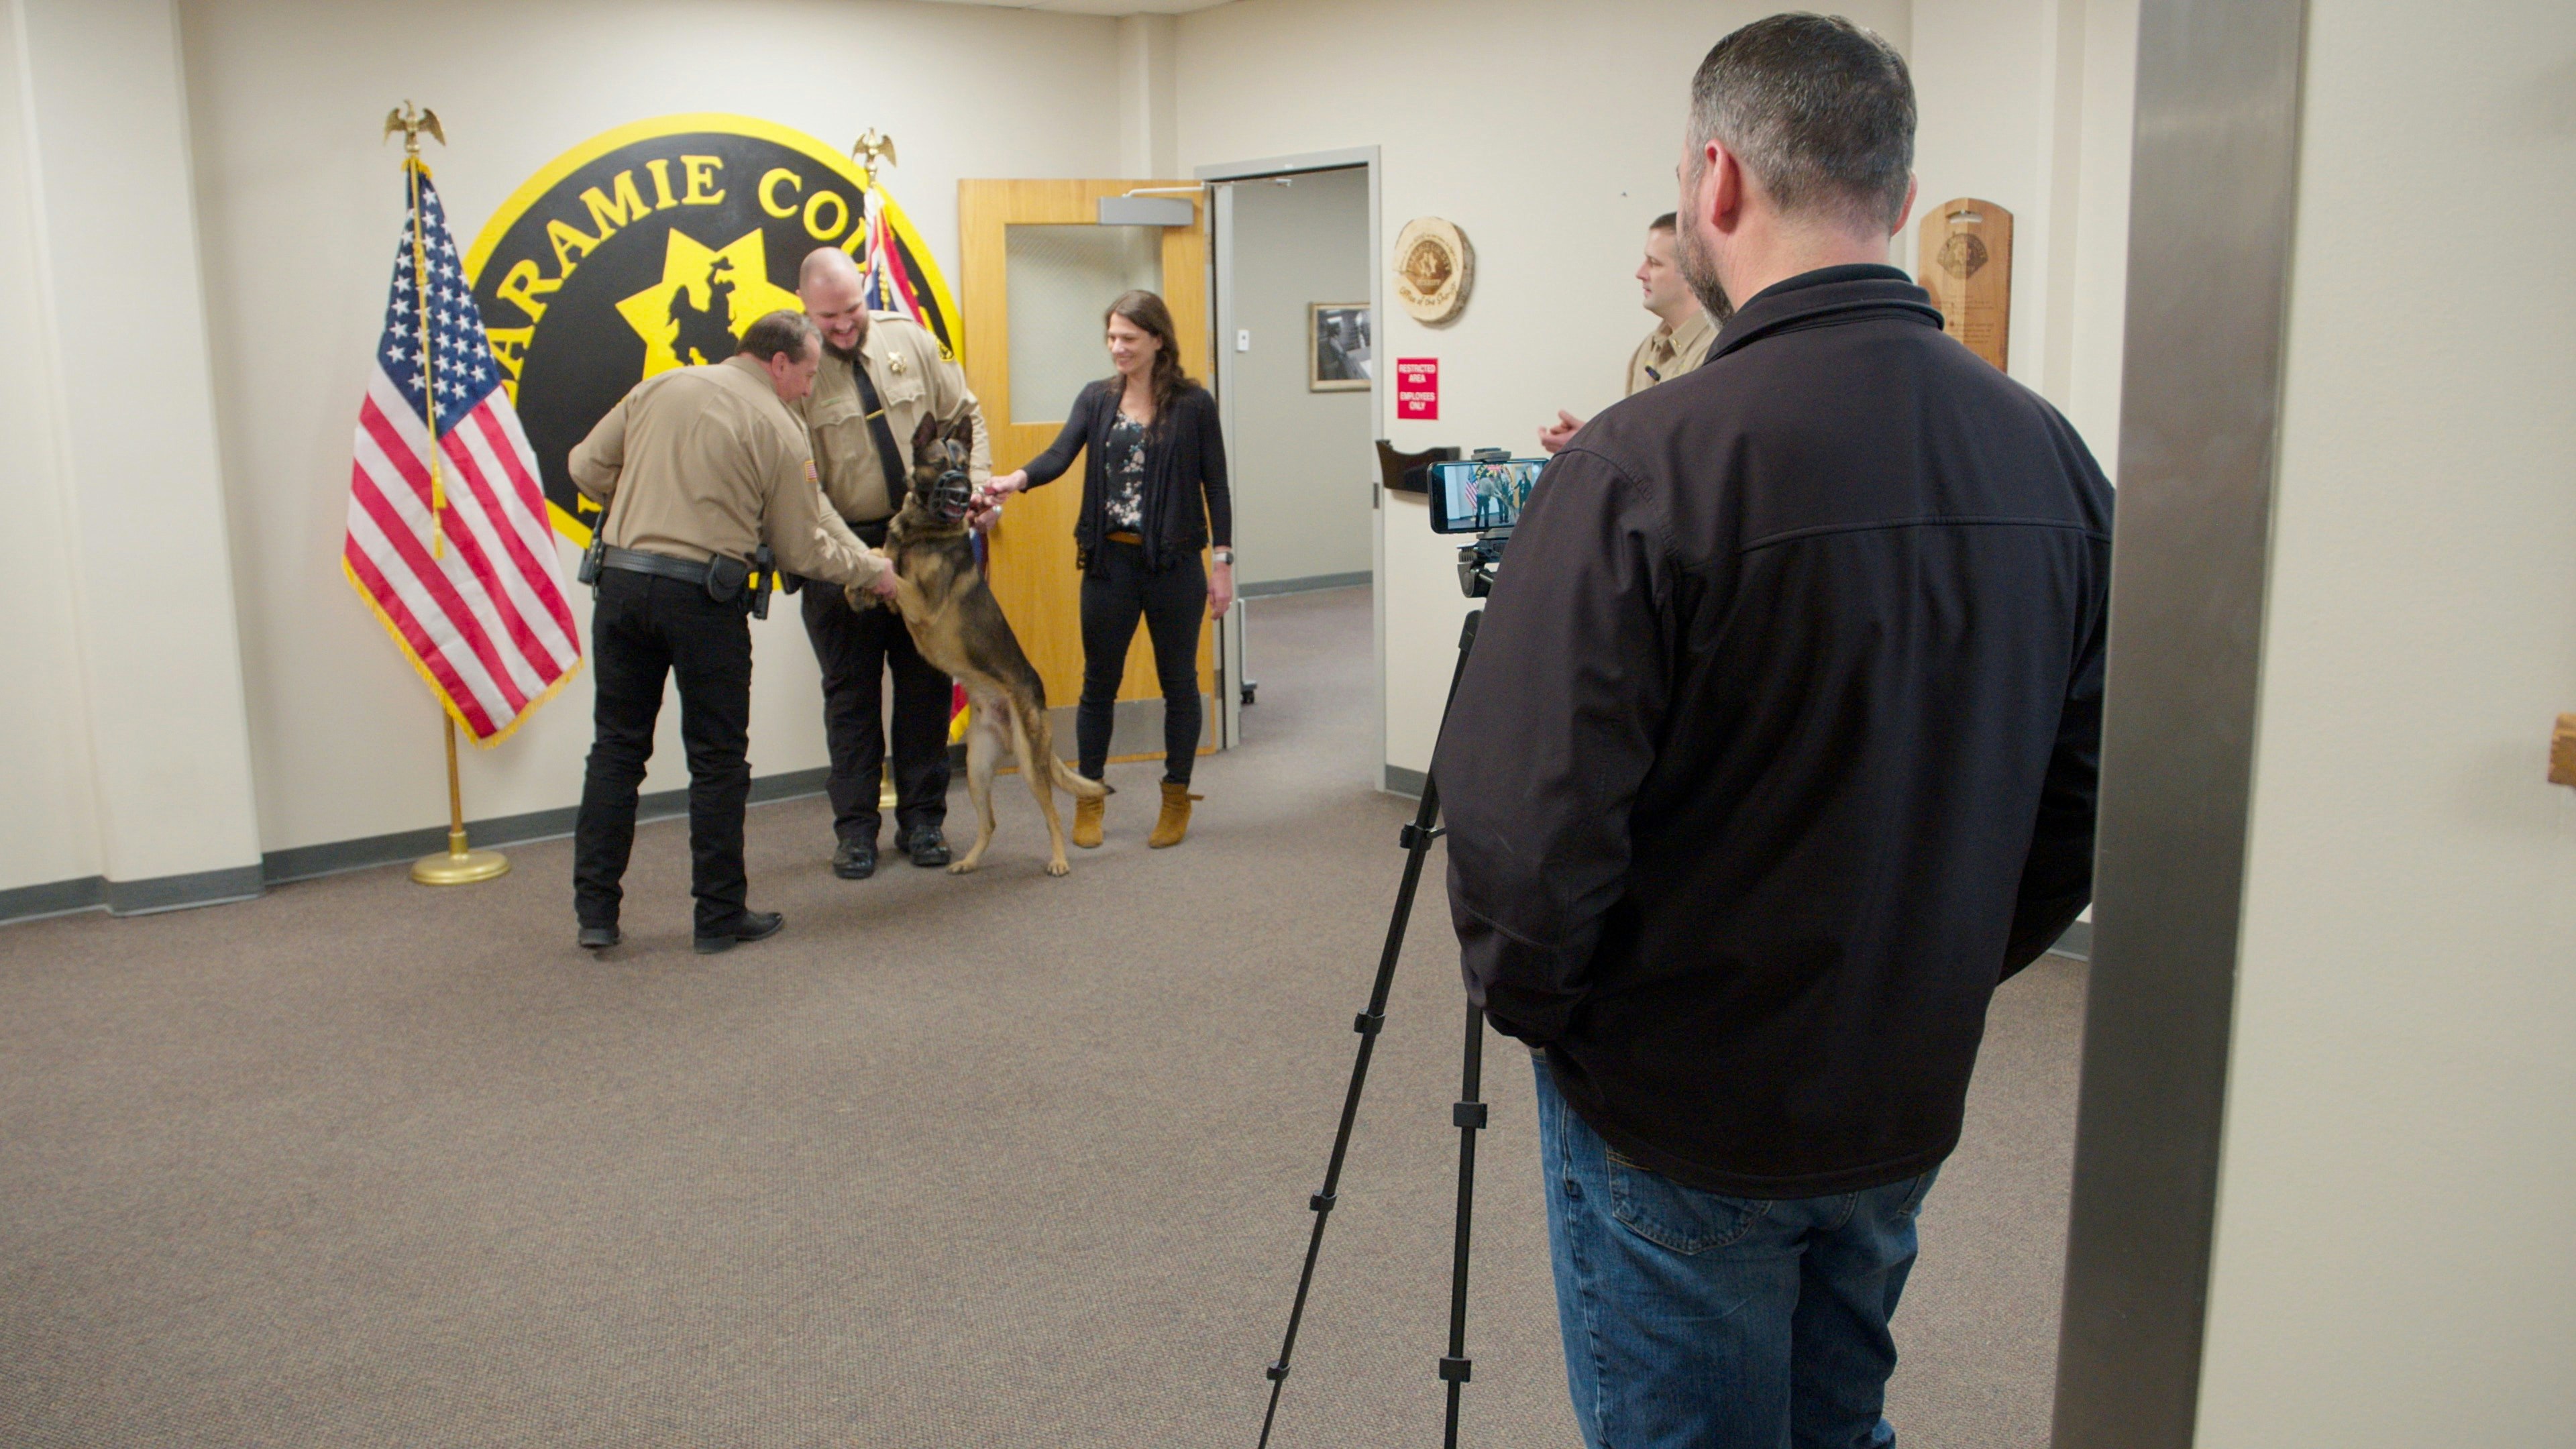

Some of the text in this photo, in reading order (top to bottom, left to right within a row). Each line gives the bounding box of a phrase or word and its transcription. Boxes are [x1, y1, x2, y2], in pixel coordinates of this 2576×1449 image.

[1399, 364, 1436, 374] RESTRICTED
[1408, 374, 1426, 383] AREA
[1400, 391, 1436, 402] EMPLOYEES
[1409, 401, 1426, 411] ONLY
